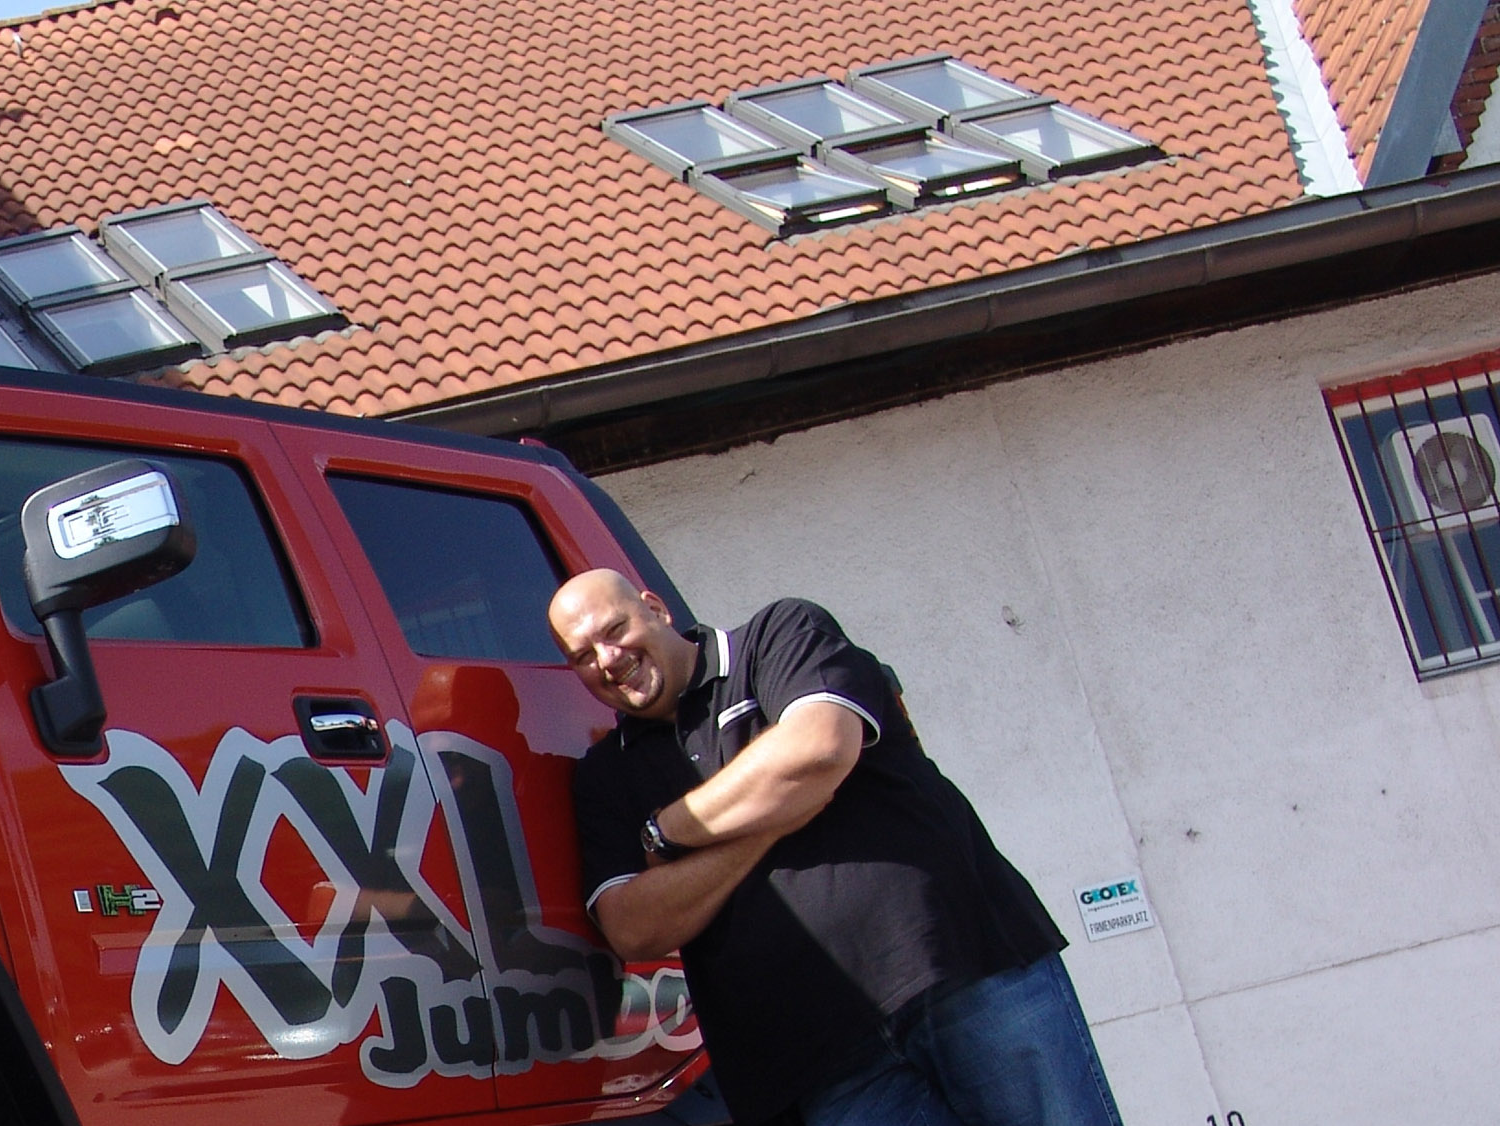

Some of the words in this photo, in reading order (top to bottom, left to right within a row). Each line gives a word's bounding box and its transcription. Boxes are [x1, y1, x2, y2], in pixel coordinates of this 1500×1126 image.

[57, 718, 612, 1065] XXL
[1080, 880, 1138, 905] GEOTEX
[1089, 910, 1148, 935] FIRMENPARKPLATZ
